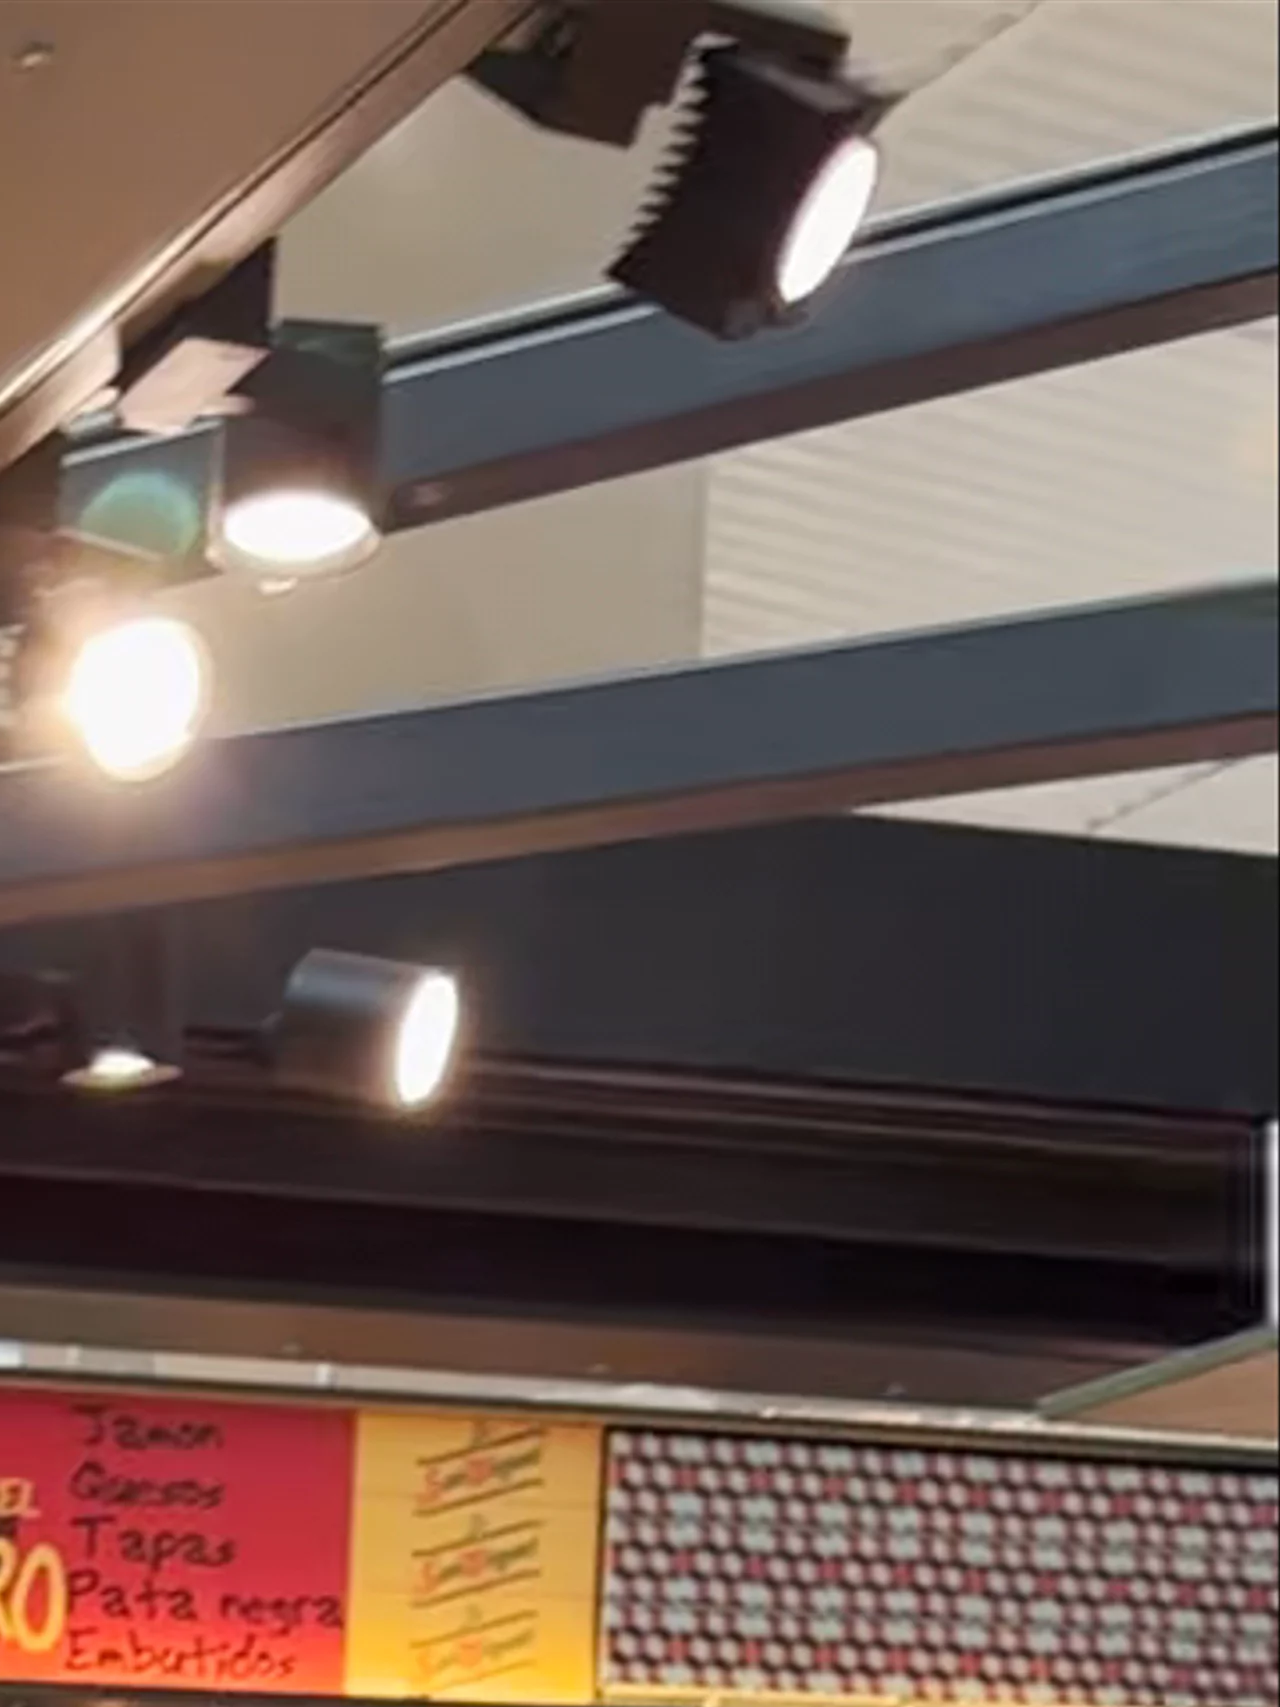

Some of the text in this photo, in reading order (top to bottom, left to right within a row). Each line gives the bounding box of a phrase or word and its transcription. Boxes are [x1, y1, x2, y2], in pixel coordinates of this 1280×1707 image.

[69, 1514, 235, 1571] Tapas
[65, 1567, 346, 1638] Pata negra
[64, 1625, 297, 1682] Embutidos
